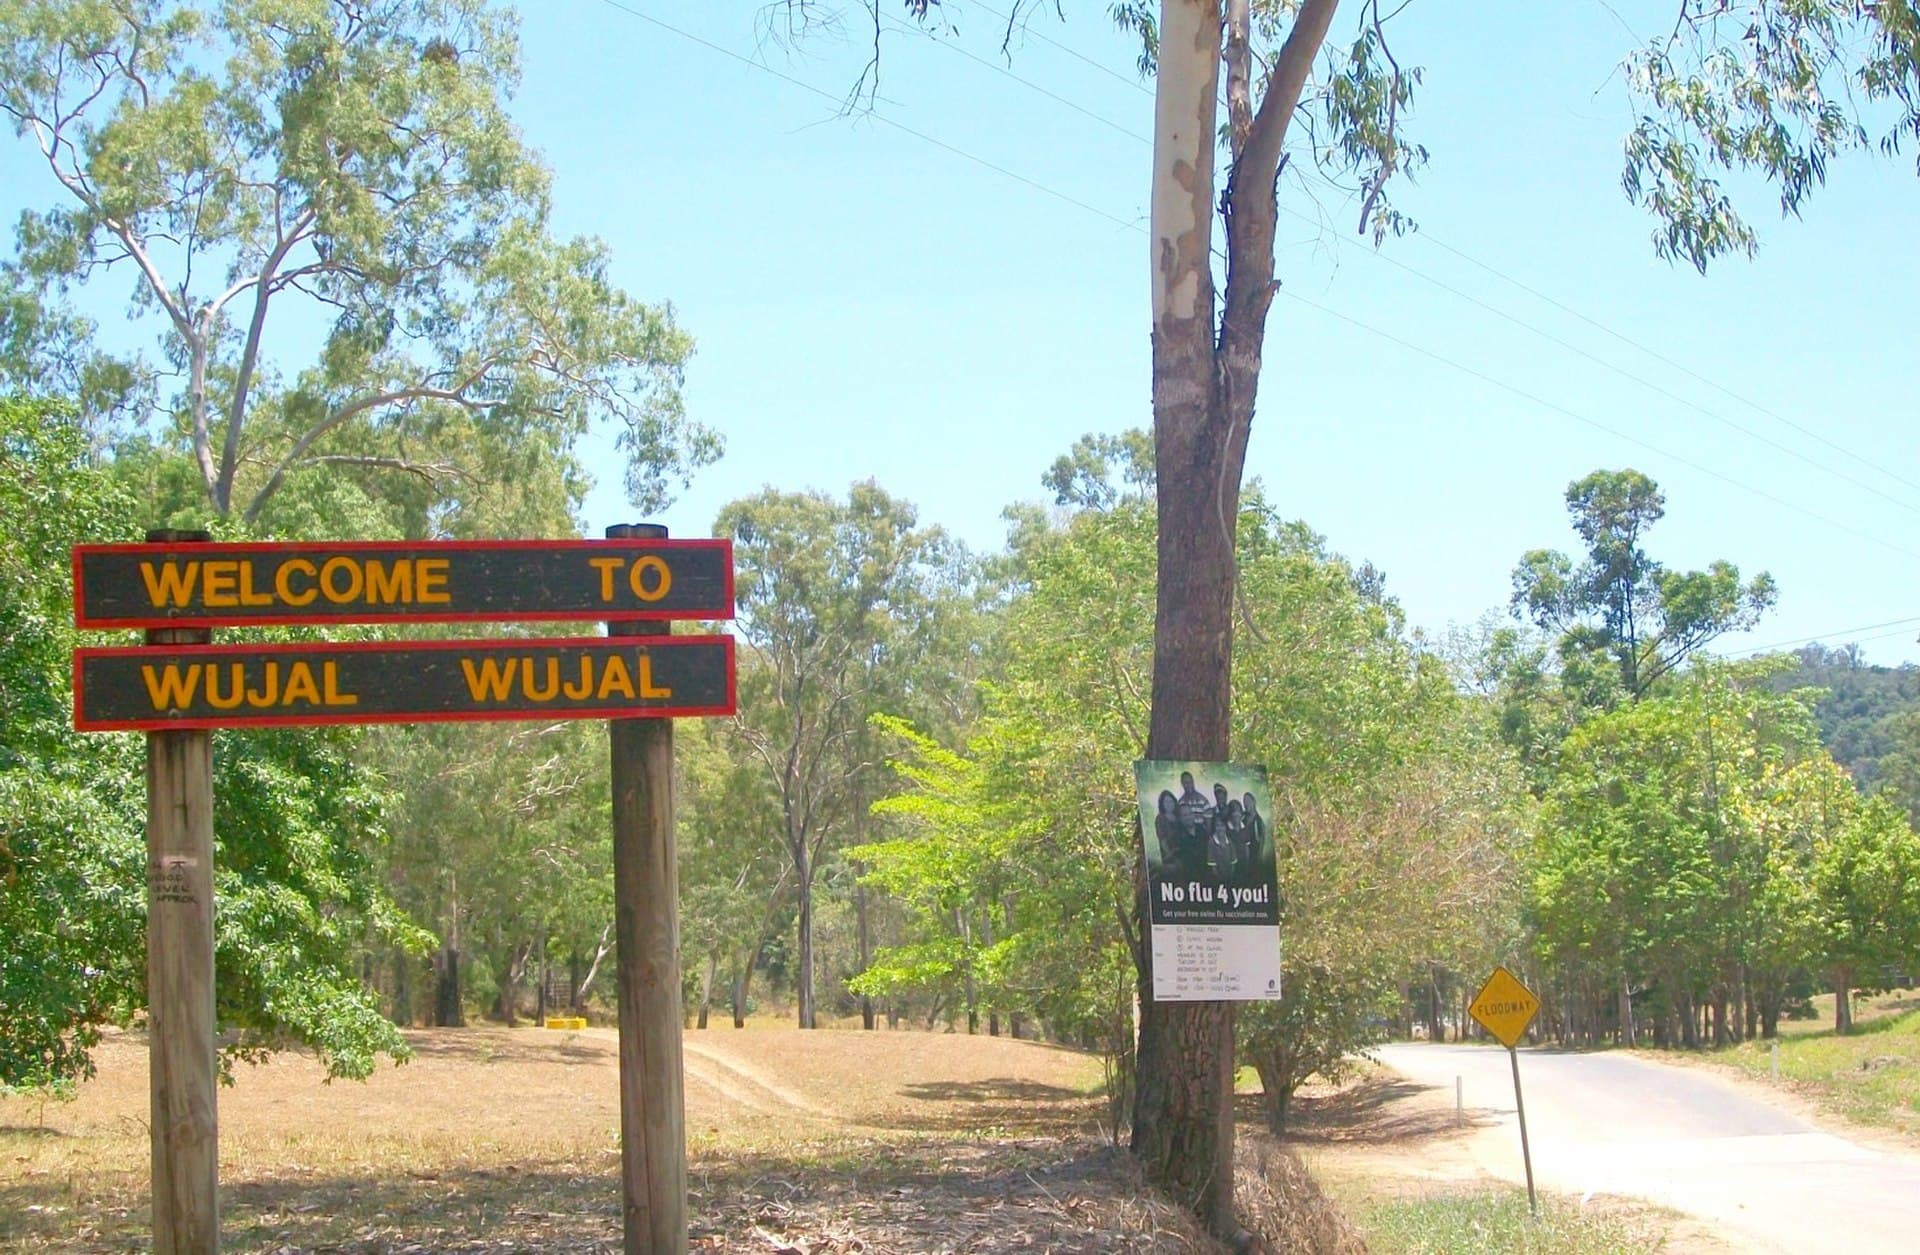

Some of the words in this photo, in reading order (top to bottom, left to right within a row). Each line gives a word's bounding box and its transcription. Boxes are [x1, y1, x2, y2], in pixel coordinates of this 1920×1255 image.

[140, 556, 450, 608] WELCOME
[589, 555, 672, 602] TO
[142, 661, 358, 710] WUJAL
[461, 654, 672, 701] WUJAL
[1160, 882, 1185, 902] No
[1188, 881, 1213, 902] flu
[1217, 884, 1229, 904] 4
[1231, 884, 1269, 908] you!
[1162, 909, 1173, 918] Get
[1174, 910, 1187, 919] your
[1477, 1000, 1530, 1017] FLOODWAY
